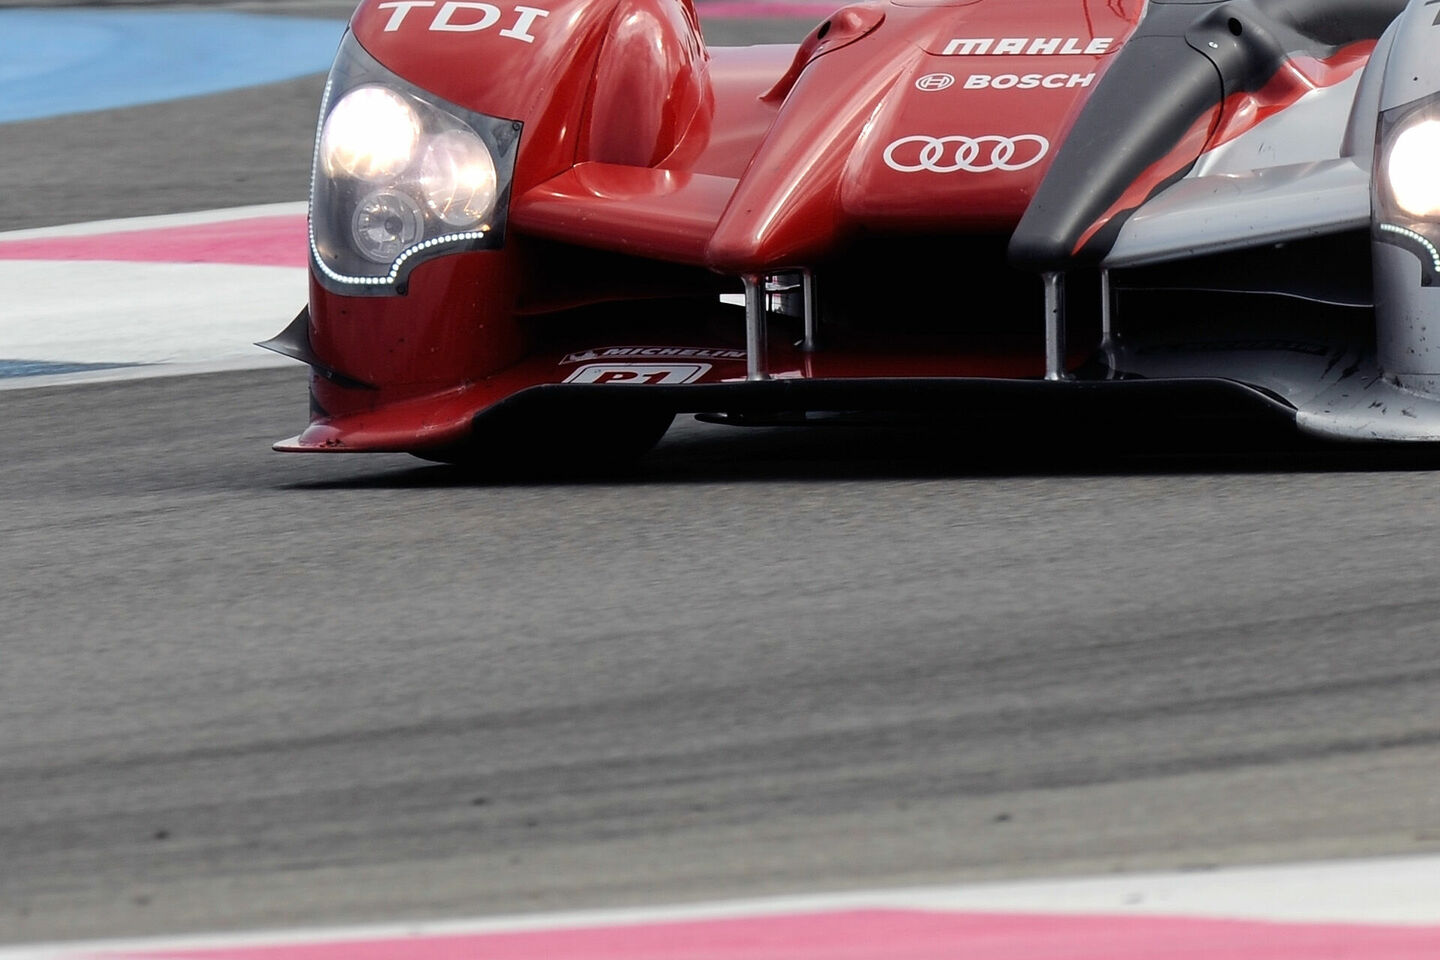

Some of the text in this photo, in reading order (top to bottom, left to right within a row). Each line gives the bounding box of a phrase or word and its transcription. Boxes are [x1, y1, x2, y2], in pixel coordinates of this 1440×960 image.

[377, 0, 550, 44] TDI
[942, 37, 1115, 55] MAHLE
[963, 72, 1096, 90] BOSCH
[603, 347, 747, 358] MICHELIN
